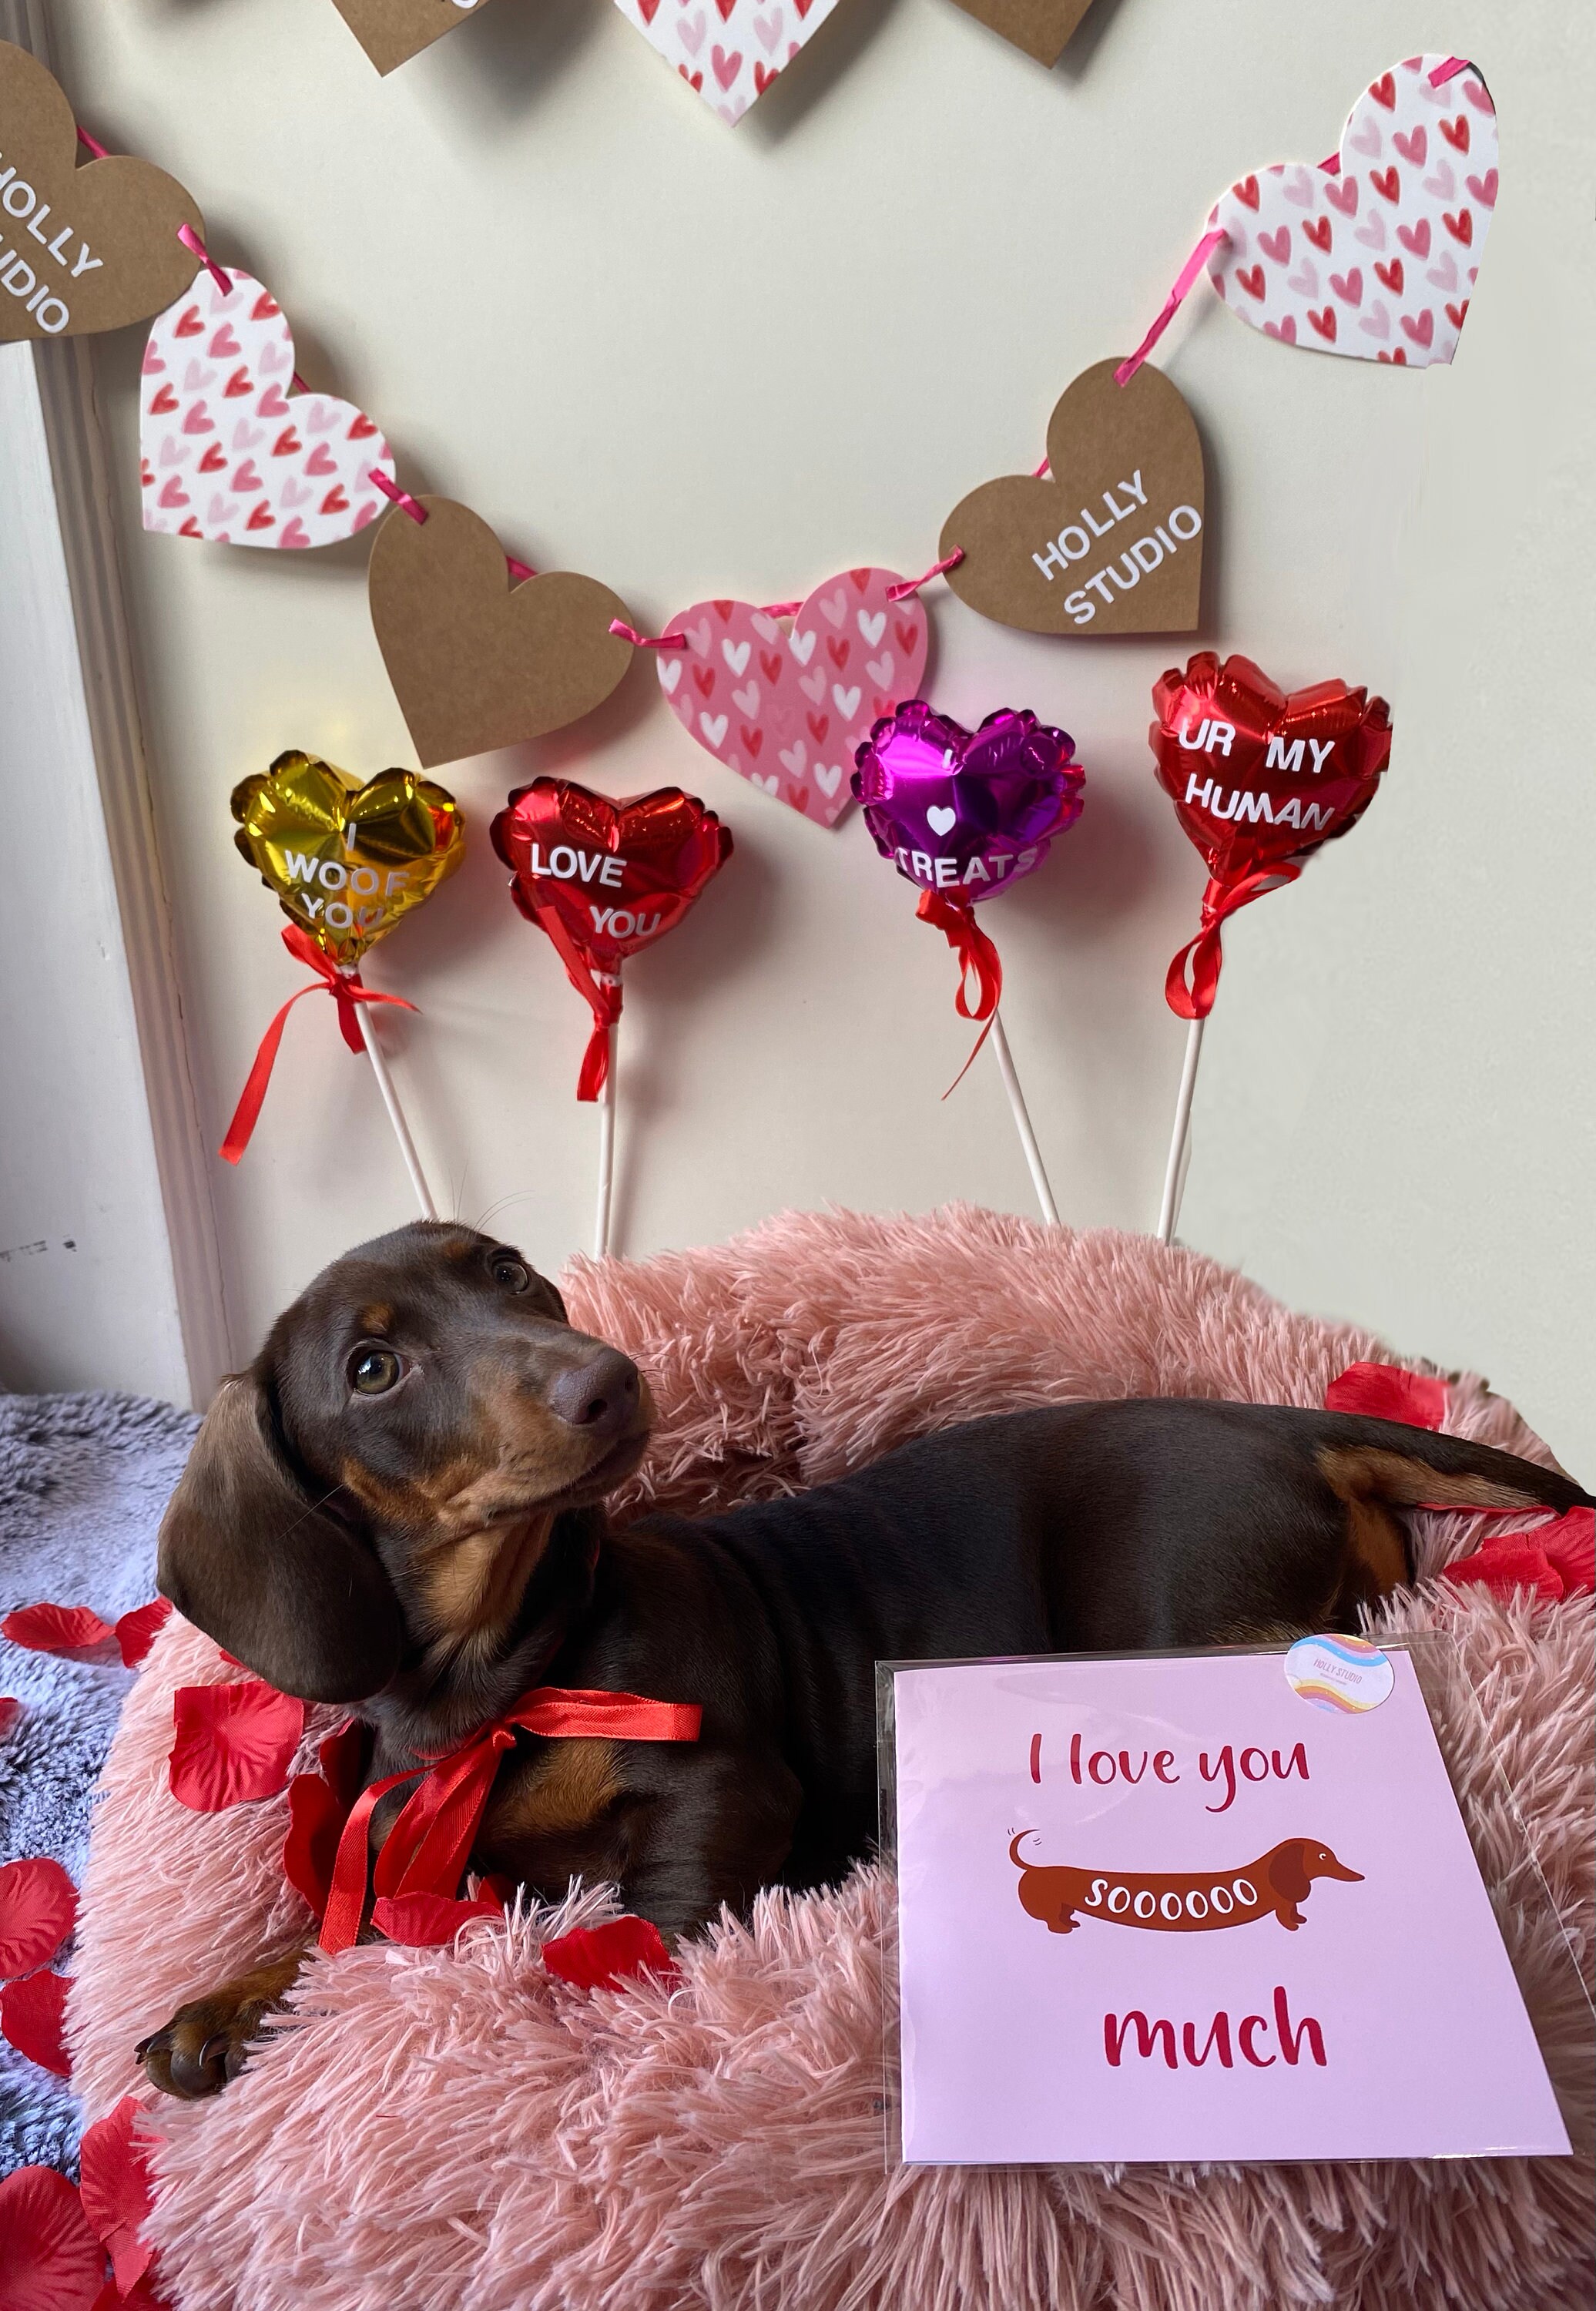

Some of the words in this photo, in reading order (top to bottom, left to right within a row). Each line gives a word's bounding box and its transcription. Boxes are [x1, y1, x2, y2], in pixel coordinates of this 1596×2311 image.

[0, 233, 69, 334] DIO
[1032, 469, 1148, 581] HOLLY
[1064, 505, 1202, 624] STUDIO
[942, 749, 953, 769] I
[1179, 717, 1236, 756] UR
[1266, 736, 1335, 773] MY
[1185, 773, 1335, 830] HUMAN
[347, 822, 357, 850] I
[285, 850, 410, 897] WOOF
[531, 843, 627, 887] LOVE
[894, 846, 1038, 887] TREATS
[301, 893, 384, 928] YOU
[589, 906, 661, 939] YOU
[1313, 1659, 1337, 1673] HOLLY
[1336, 1668, 1363, 1684] STUDIO
[1031, 1733, 1041, 1783] I
[1070, 1733, 1180, 1784] love
[1199, 1742, 1309, 1813] you
[1104, 1985, 1327, 2069] much
